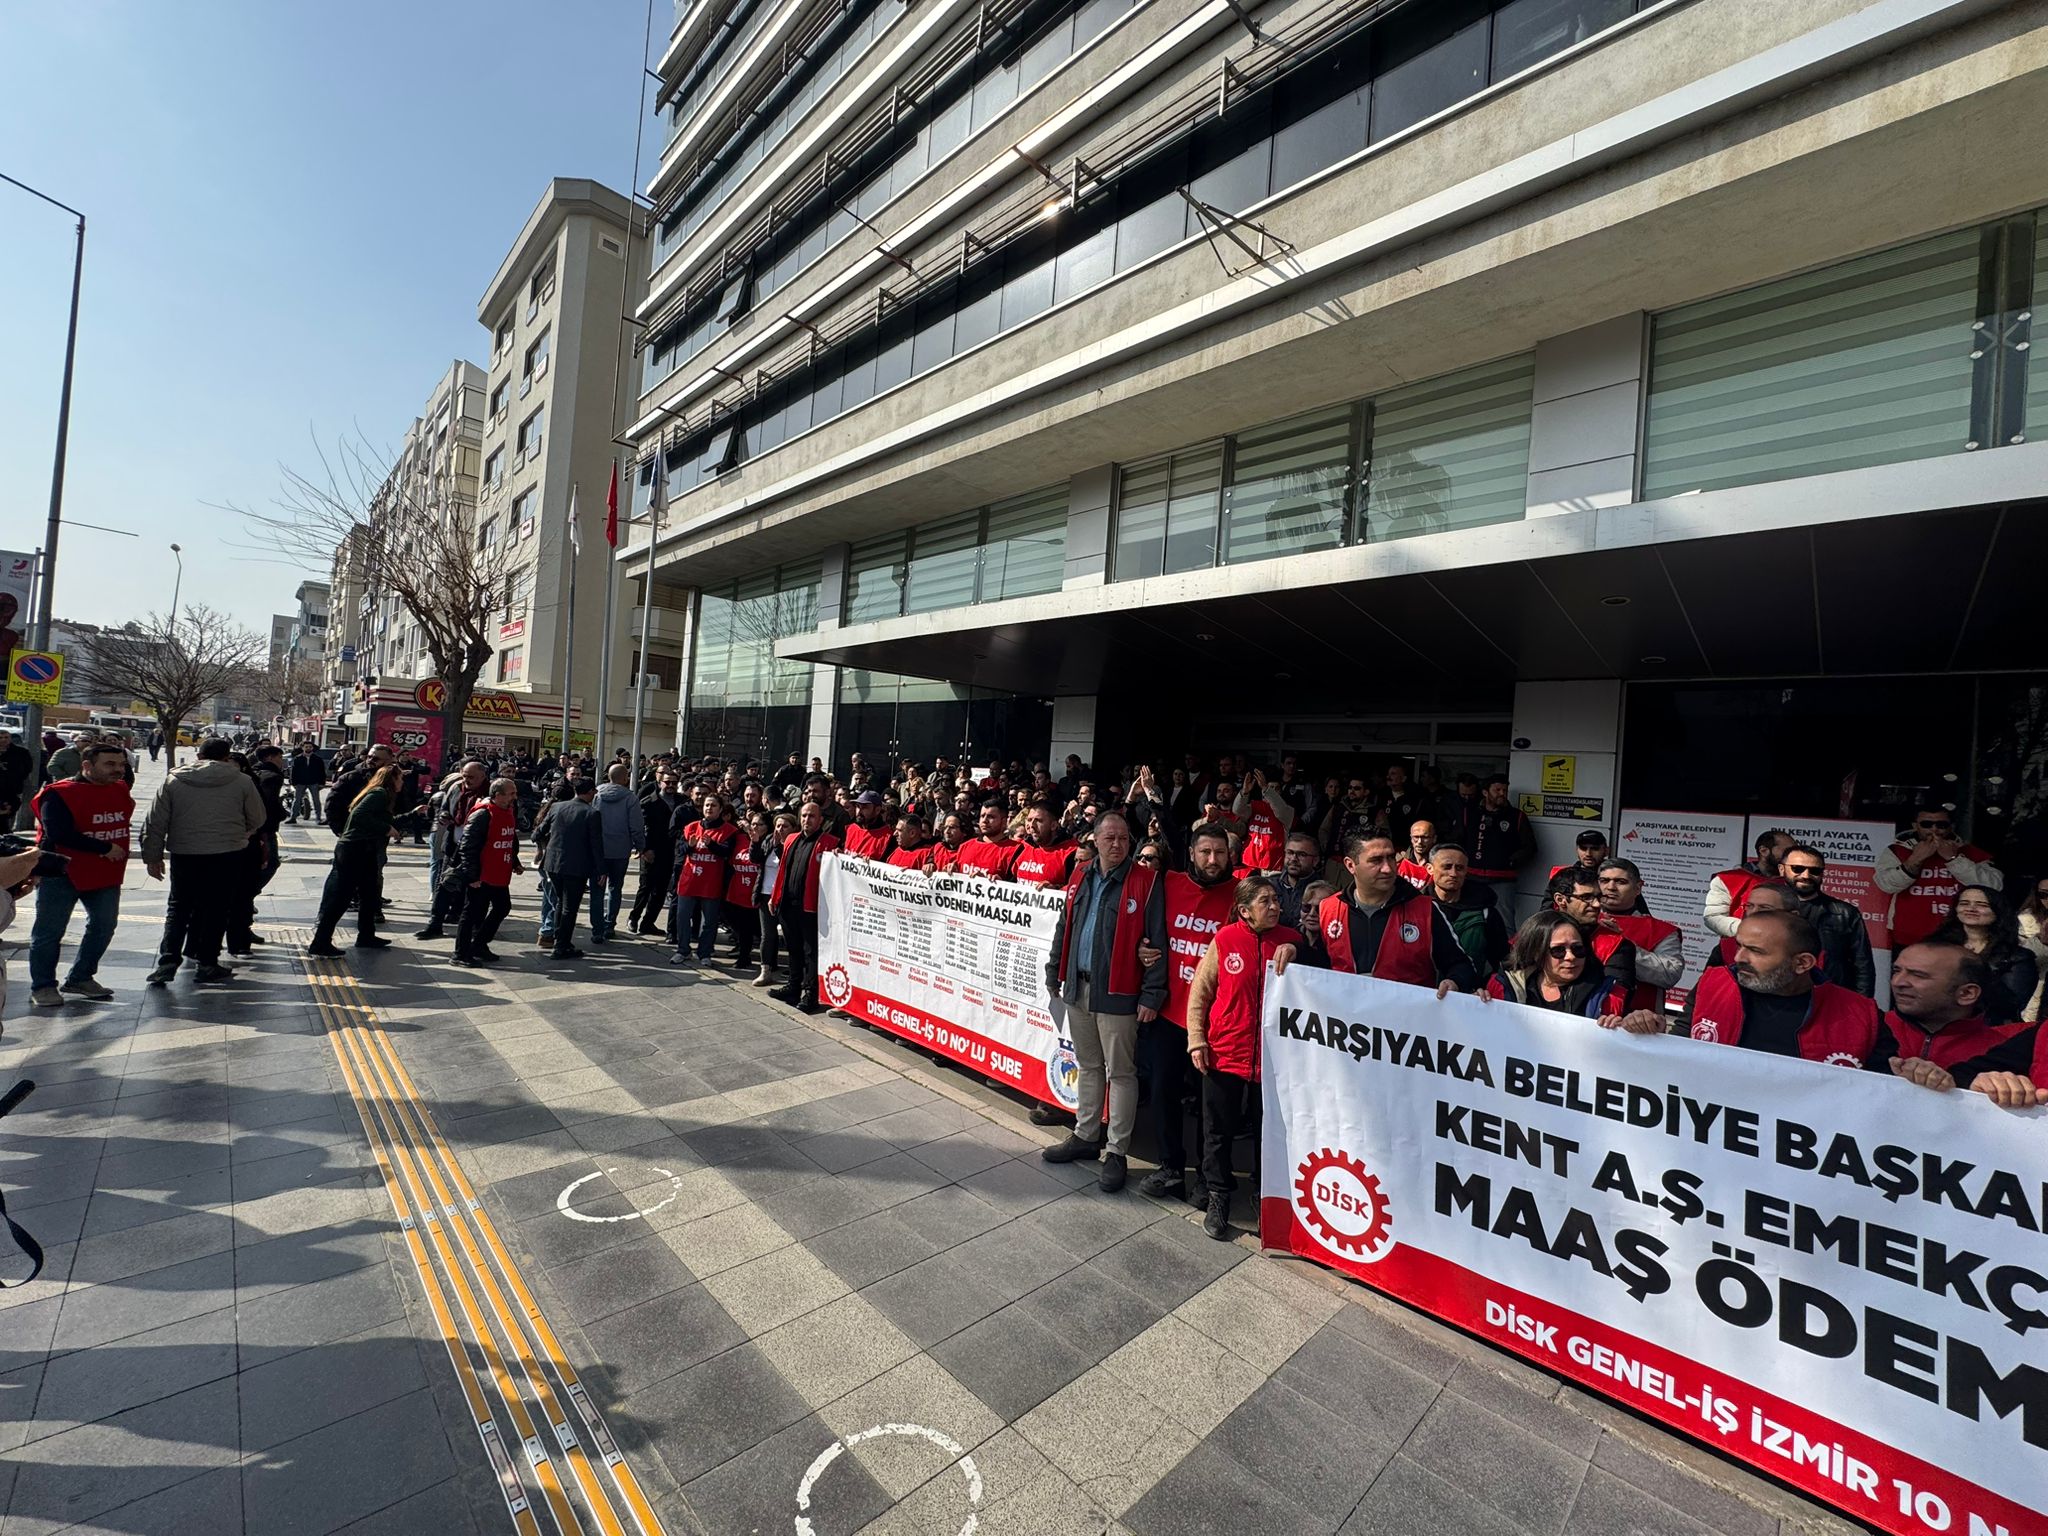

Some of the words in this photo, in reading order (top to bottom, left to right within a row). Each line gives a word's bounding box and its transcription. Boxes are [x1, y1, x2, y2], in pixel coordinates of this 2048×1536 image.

[392, 732, 427, 745] %50
[92, 811, 125, 824] DİSK
[1635, 822, 1678, 831] KARŞIYAKA
[1680, 824, 1726, 834] BELEDİYESİ
[1789, 828, 1821, 838] KENTİ
[1824, 831, 1870, 841] AYAKTA
[1682, 832, 1697, 840] A.Ş.
[1642, 837, 1663, 845] İŞÇİSİ
[1678, 841, 1716, 849] YAŞIYOR?
[1828, 841, 1872, 852] AÇLIĞA
[691, 853, 717, 862] ENEL
[735, 852, 750, 861] DİS
[1822, 850, 1876, 863] DİLEMEZ!
[1019, 859, 1045, 874] DİSK
[1920, 867, 1953, 879] DİS
[1823, 869, 1859, 878] ŞÇİLERİ
[840, 859, 881, 880] KARŞIYAKA
[935, 879, 964, 893] KENT
[965, 882, 985, 899] A.Ş.
[987, 886, 1064, 912] ÇALIŞANLAR
[1831, 886, 1868, 896] ALIYOR.
[1909, 886, 1957, 897] GENE
[868, 883, 897, 900] TAKSİT
[900, 889, 933, 906] TAKSİT
[935, 893, 973, 915] ÖDENEN
[975, 903, 1032, 928] MAAŞLAR
[1174, 912, 1222, 934] DİSK
[996, 946, 1010, 955] 7.000
[1169, 937, 1211, 958] GENE
[1179, 961, 1195, 984] İŞ
[1026, 1008, 1041, 1019] OCAK
[1026, 1017, 1054, 1032] ÖDENMEDİ
[867, 999, 889, 1020] DİSK
[890, 1009, 935, 1042] GENEL-İŞ
[936, 1027, 948, 1045] 10
[949, 1033, 970, 1053] NO'
[970, 1042, 986, 1062] LU
[989, 1051, 1023, 1079] ŞUBE
[1278, 1006, 1495, 1089] KARŞIYAKA
[1504, 1055, 1760, 1158] BELEDİYE
[1316, 1181, 1370, 1220] DİSK
[1435, 1100, 1580, 1179] KENT
[1591, 1150, 1725, 1229] A.Ş.
[1744, 1188, 2048, 1337] EMEKÇ
[1434, 1161, 1672, 1304] MAAŞ
[1695, 1240, 2048, 1453] ÖDEM
[1485, 1298, 1559, 1355] DİSK
[1567, 1335, 1739, 1435] GENEL-İŞ
[1751, 1405, 1880, 1502] İZMİR
[1892, 1478, 1952, 1531] 10
[1969, 1511, 2011, 1536] N
